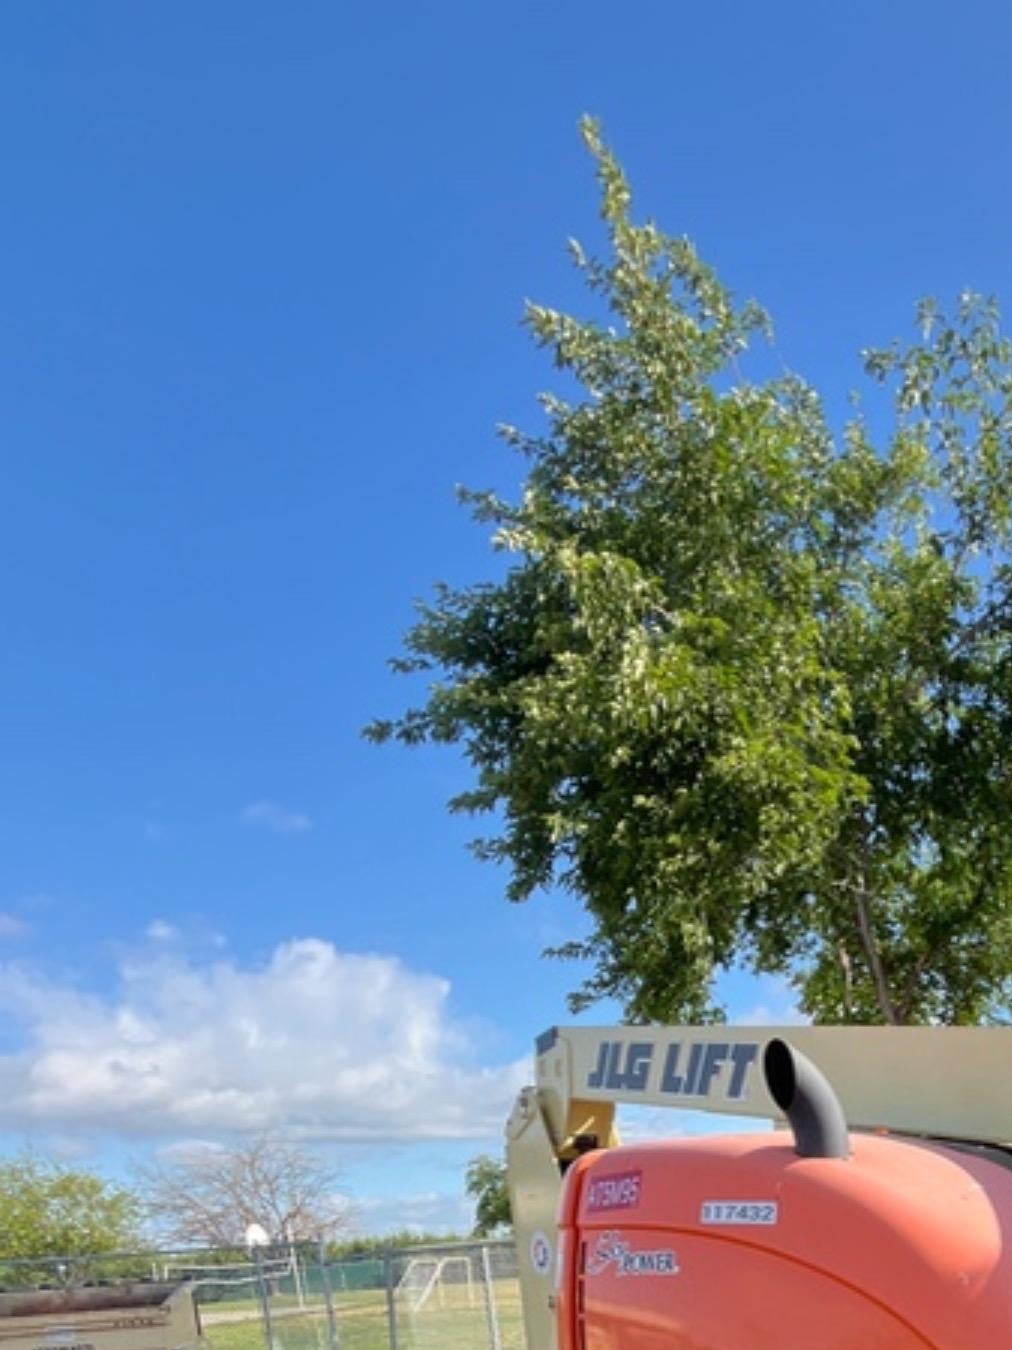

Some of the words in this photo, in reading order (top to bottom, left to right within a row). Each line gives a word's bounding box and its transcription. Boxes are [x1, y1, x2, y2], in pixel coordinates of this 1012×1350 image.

[587, 1041, 655, 1089] JLG
[660, 1043, 758, 1099] LIFT
[702, 1204, 776, 1222] 117432
